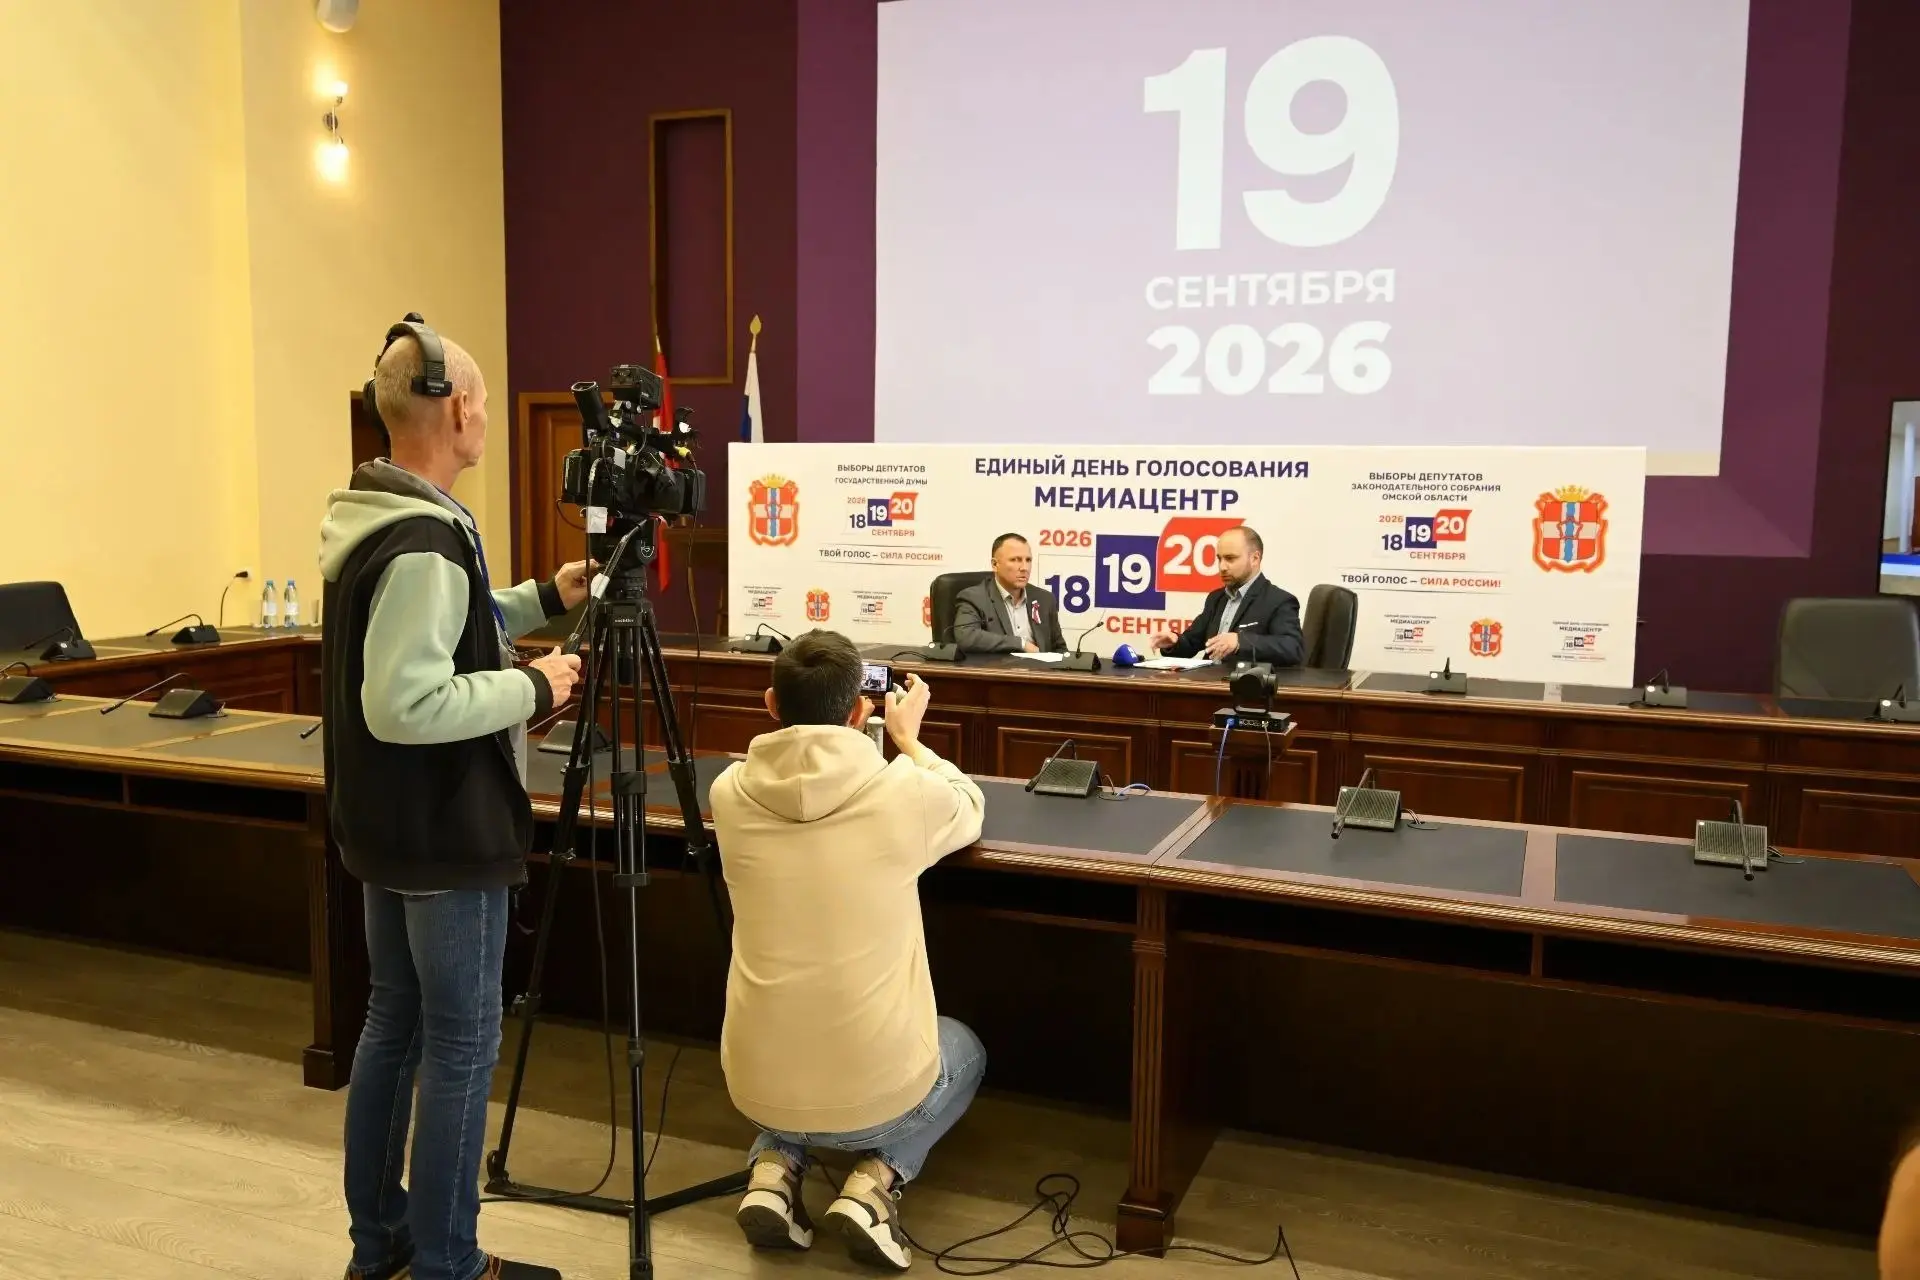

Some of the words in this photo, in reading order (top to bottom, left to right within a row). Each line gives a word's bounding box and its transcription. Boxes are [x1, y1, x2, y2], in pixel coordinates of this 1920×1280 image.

[1144, 35, 1399, 250] 19
[1145, 268, 1395, 309] СЕНТЯБРЯ
[1146, 321, 1392, 396] 2026
[837, 464, 874, 472] ВЫБОРЫ
[876, 465, 926, 473] ДЕПУТАТОВ
[975, 454, 1065, 476] ЕДИНЫЙ
[1071, 459, 1129, 477] ДЕНЬ
[1136, 460, 1309, 478] ГОЛОСОВАНИЯ
[835, 476, 905, 485] ГОСУДАРСТВЕННОЙ
[1369, 472, 1416, 480] ВЫБОРЫ
[1419, 473, 1483, 481] ДЕПУТАТОВ
[1352, 483, 1448, 491] ЗАКОНОДАТЕЛЬНОГО
[1450, 484, 1501, 492] СОБРАНИЯ
[1034, 486, 1239, 514] МЕДИАЦЕНТР
[1382, 492, 1422, 501] ОМСКОЙ
[1424, 494, 1468, 502] ОБЛАСТИ
[849, 514, 866, 529] 18
[869, 505, 888, 521] 19
[891, 498, 913, 514] 20
[871, 529, 915, 537] СЕНТЯБРЯ
[1039, 530, 1092, 547] 2026
[1381, 534, 1403, 551] 18
[1408, 524, 1432, 543] 19
[1436, 516, 1465, 535] 20
[819, 548, 841, 557] ТВОЙ
[843, 550, 871, 558] ГОЛОС
[880, 552, 903, 560] СИЛА
[905, 553, 943, 561] РОССИИ!
[1409, 551, 1466, 560] СЕНТЯБРЯ
[1045, 575, 1091, 613] 18
[1103, 553, 1151, 594] 19
[1163, 534, 1219, 576] 20
[1341, 574, 1369, 583] ТВОЙ
[1372, 576, 1408, 584] ГОЛОС
[1420, 577, 1450, 586] СИЛА
[1453, 578, 1501, 588] РОССИИ!
